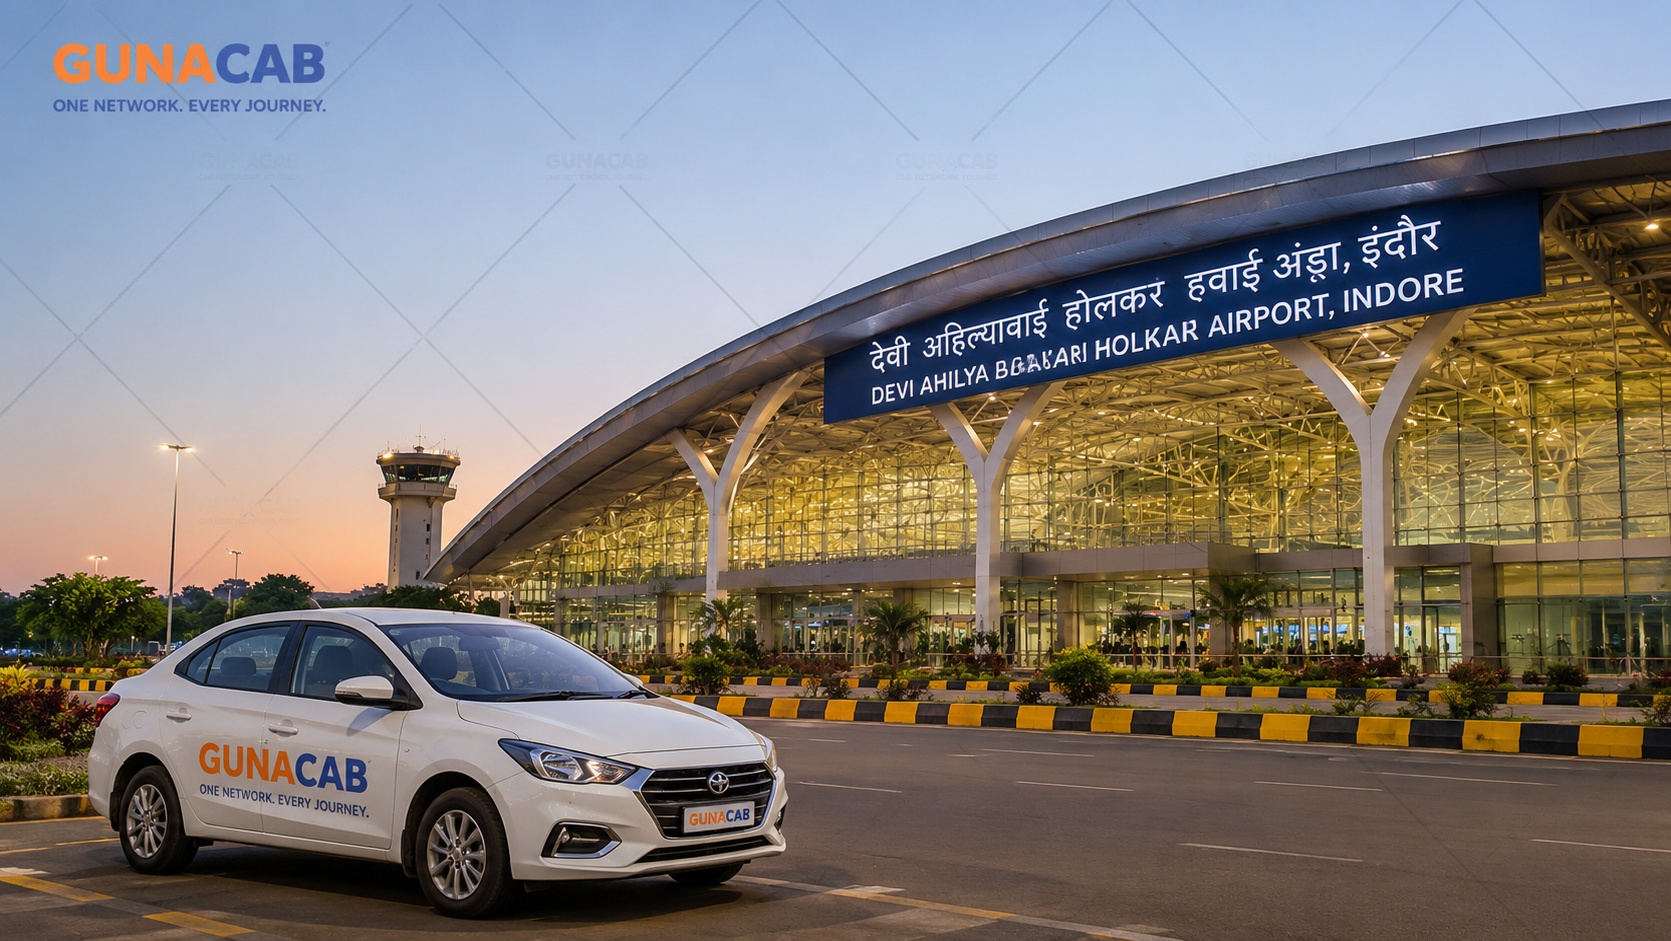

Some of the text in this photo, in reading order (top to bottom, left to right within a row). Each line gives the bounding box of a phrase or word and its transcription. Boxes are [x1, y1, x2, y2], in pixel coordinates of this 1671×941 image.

[869, 336, 911, 373] देवी
[1062, 289, 1165, 330] होलकर
[1184, 248, 1264, 302] हवाई
[1357, 214, 1442, 269] इंदौर
[871, 379, 915, 405] DEVI
[920, 364, 989, 396] AHILYA
[1095, 319, 1199, 360] HOLKAR
[1208, 293, 1335, 338] AIRPORT,
[1343, 268, 1464, 313] INDORE
[198, 742, 368, 794] GUNACAB
[200, 783, 370, 819] ONE NETWORK. EVERY JOURNEY.
[689, 808, 750, 826] GUNACAB
